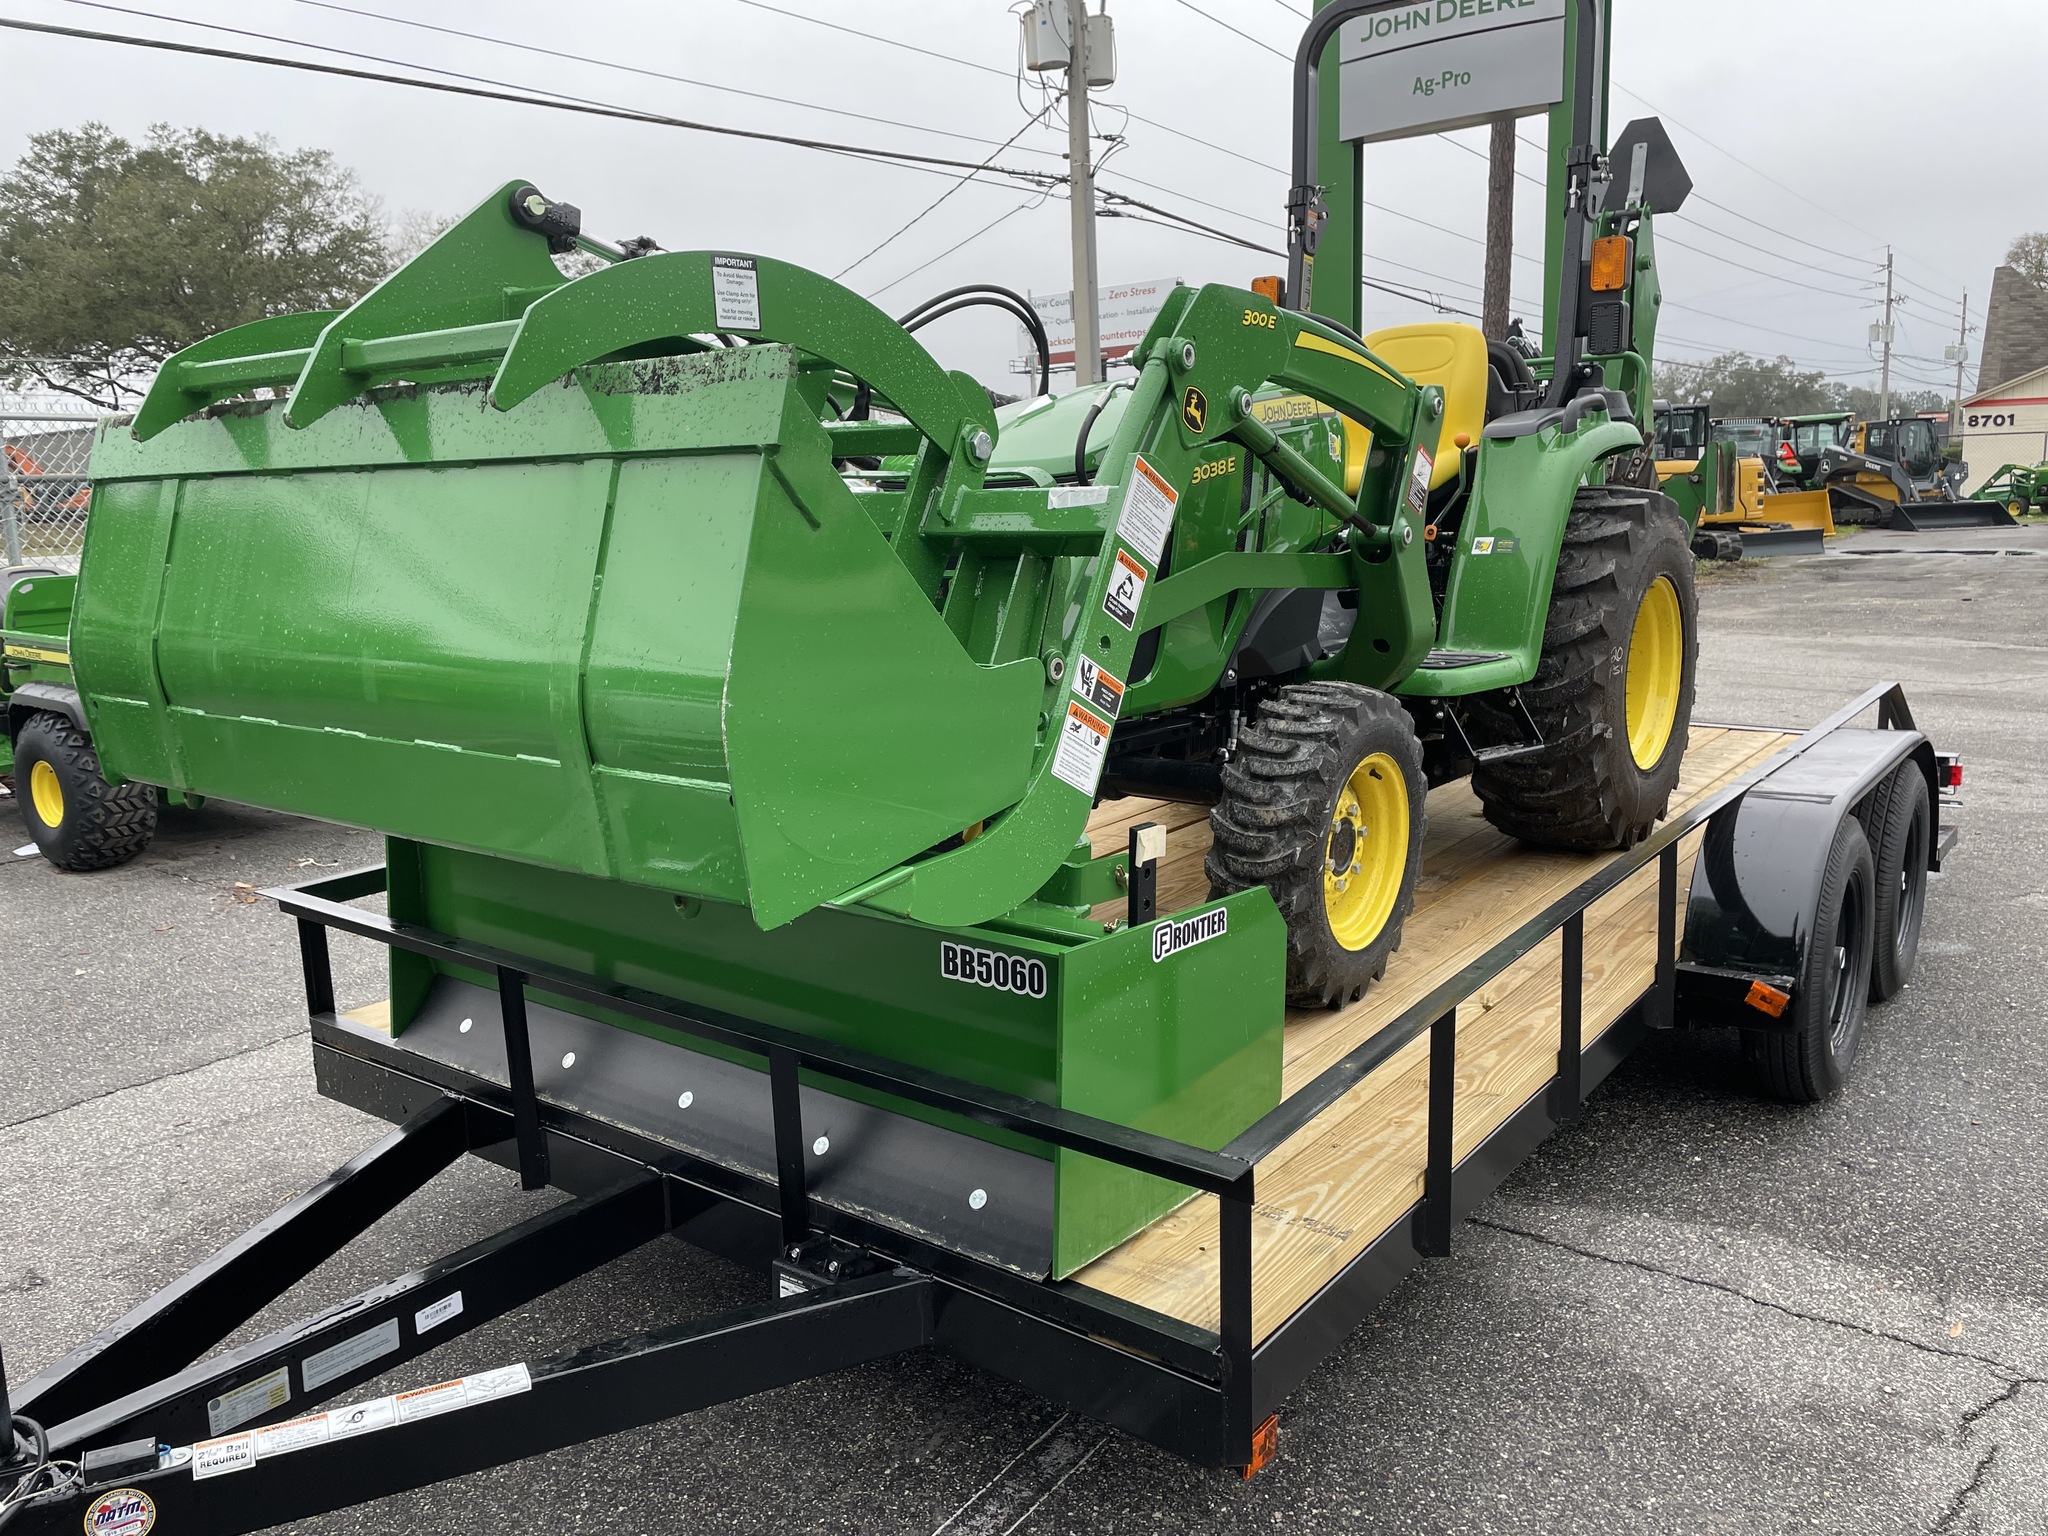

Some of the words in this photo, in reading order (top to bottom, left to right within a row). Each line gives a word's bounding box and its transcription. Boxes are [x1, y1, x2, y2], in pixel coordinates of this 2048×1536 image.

[1360, 7, 1430, 42] JOHN
[1412, 71, 1471, 96] Ag-Pro
[714, 256, 753, 268] IMPORTANT
[1108, 290, 1128, 300] Zero
[1130, 287, 1157, 297] Stress
[1262, 404, 1287, 421] JOHN
[1286, 400, 1313, 417] DEERE
[1968, 413, 2015, 428] 8701
[1865, 460, 1881, 471] DEERE
[1148, 471, 1170, 496] WARNING
[1124, 559, 1145, 579] WARNING
[1610, 646, 1624, 664] 20
[1103, 676, 1121, 692] WARNING
[1079, 709, 1106, 734] WARNING
[1153, 910, 1226, 960] FRONTIER
[942, 944, 1045, 997] BB5060
[409, 1381, 455, 1398] WARNING
[271, 1415, 321, 1430] WARNING
[226, 1441, 249, 1453] Ball
[200, 1452, 248, 1468] REQUIRED
